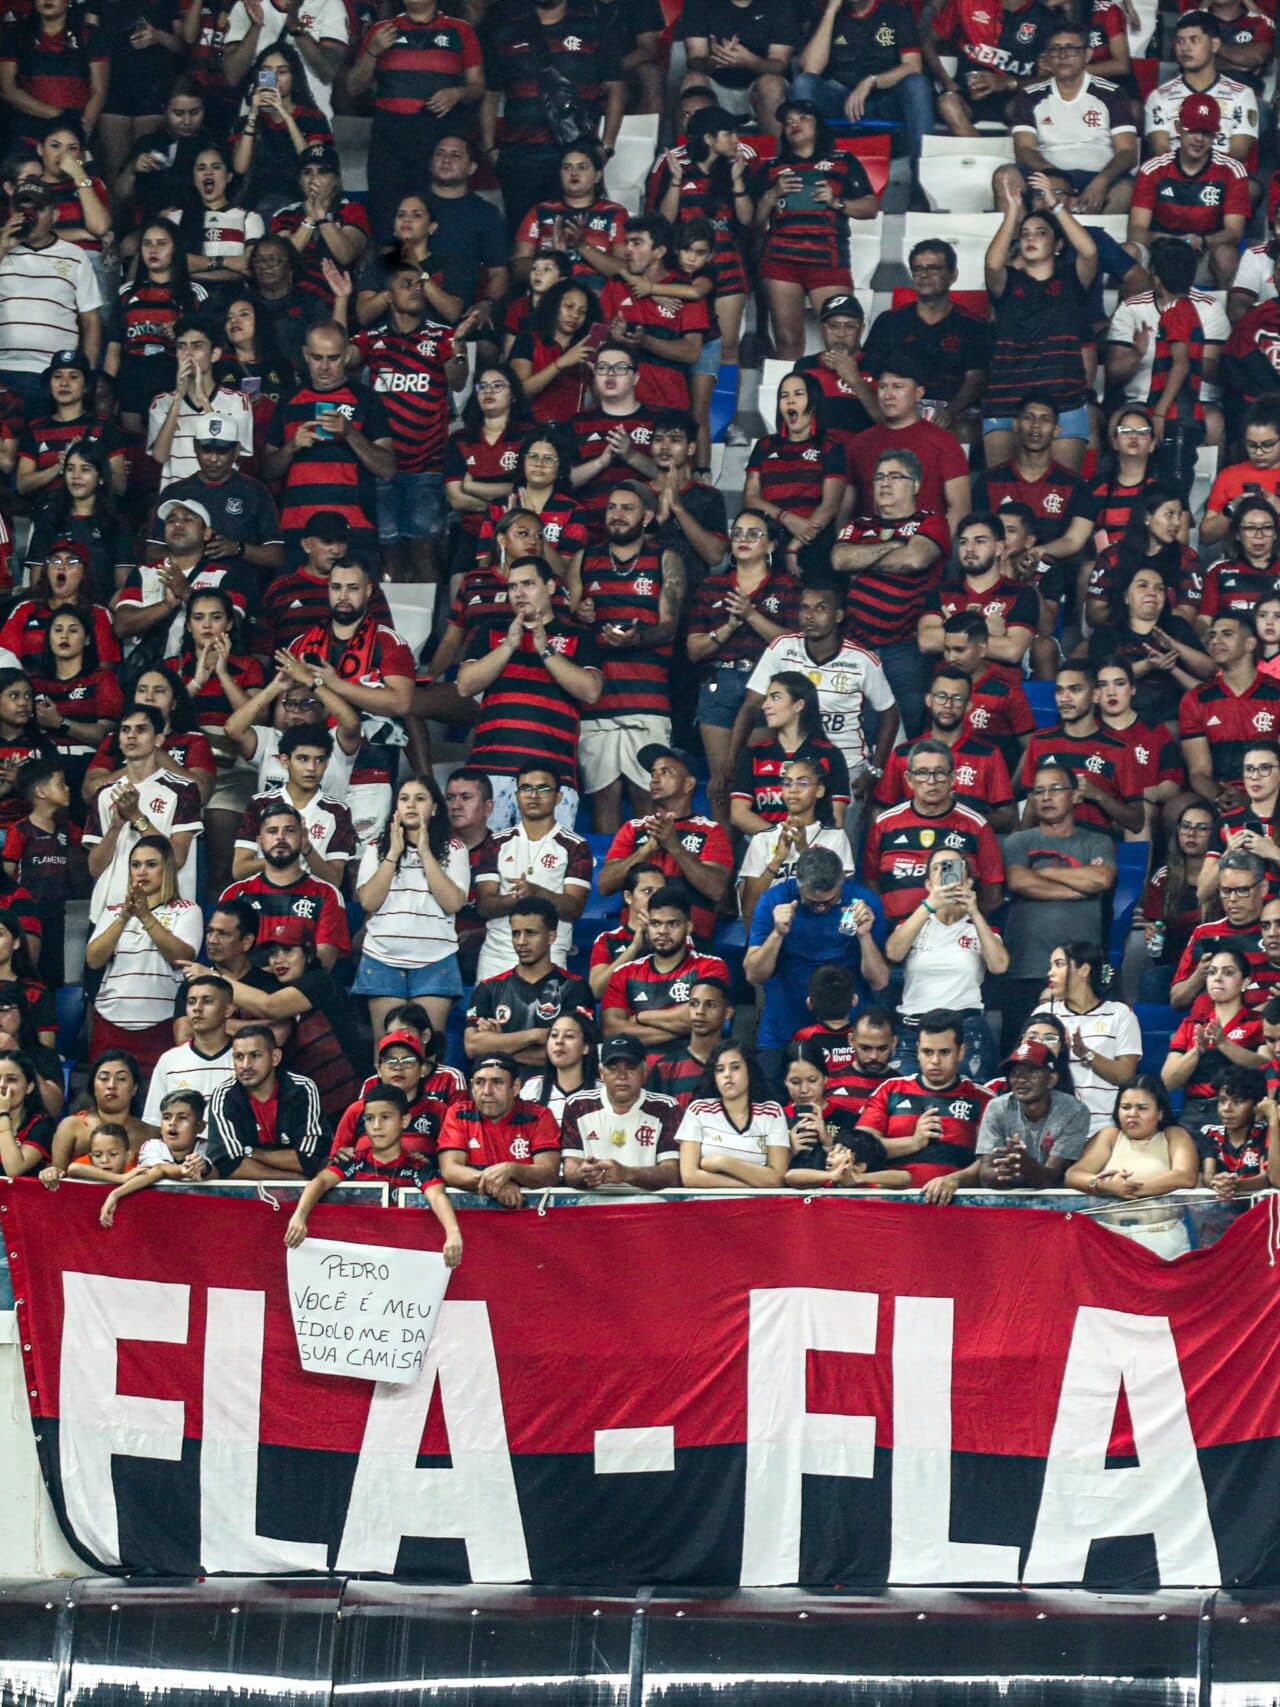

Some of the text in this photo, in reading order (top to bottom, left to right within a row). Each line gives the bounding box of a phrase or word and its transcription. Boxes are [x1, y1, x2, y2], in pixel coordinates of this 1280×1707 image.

[392, 373, 431, 393] BRB
[320, 1254, 390, 1280] PEDRO
[295, 1285, 431, 1318] VOCÊ É MEU
[296, 1315, 426, 1343] ÍDOLO ME DA
[302, 1344, 337, 1363] SUA
[62, 1271, 532, 1584] FLA
[740, 1287, 1221, 1587] FLA
